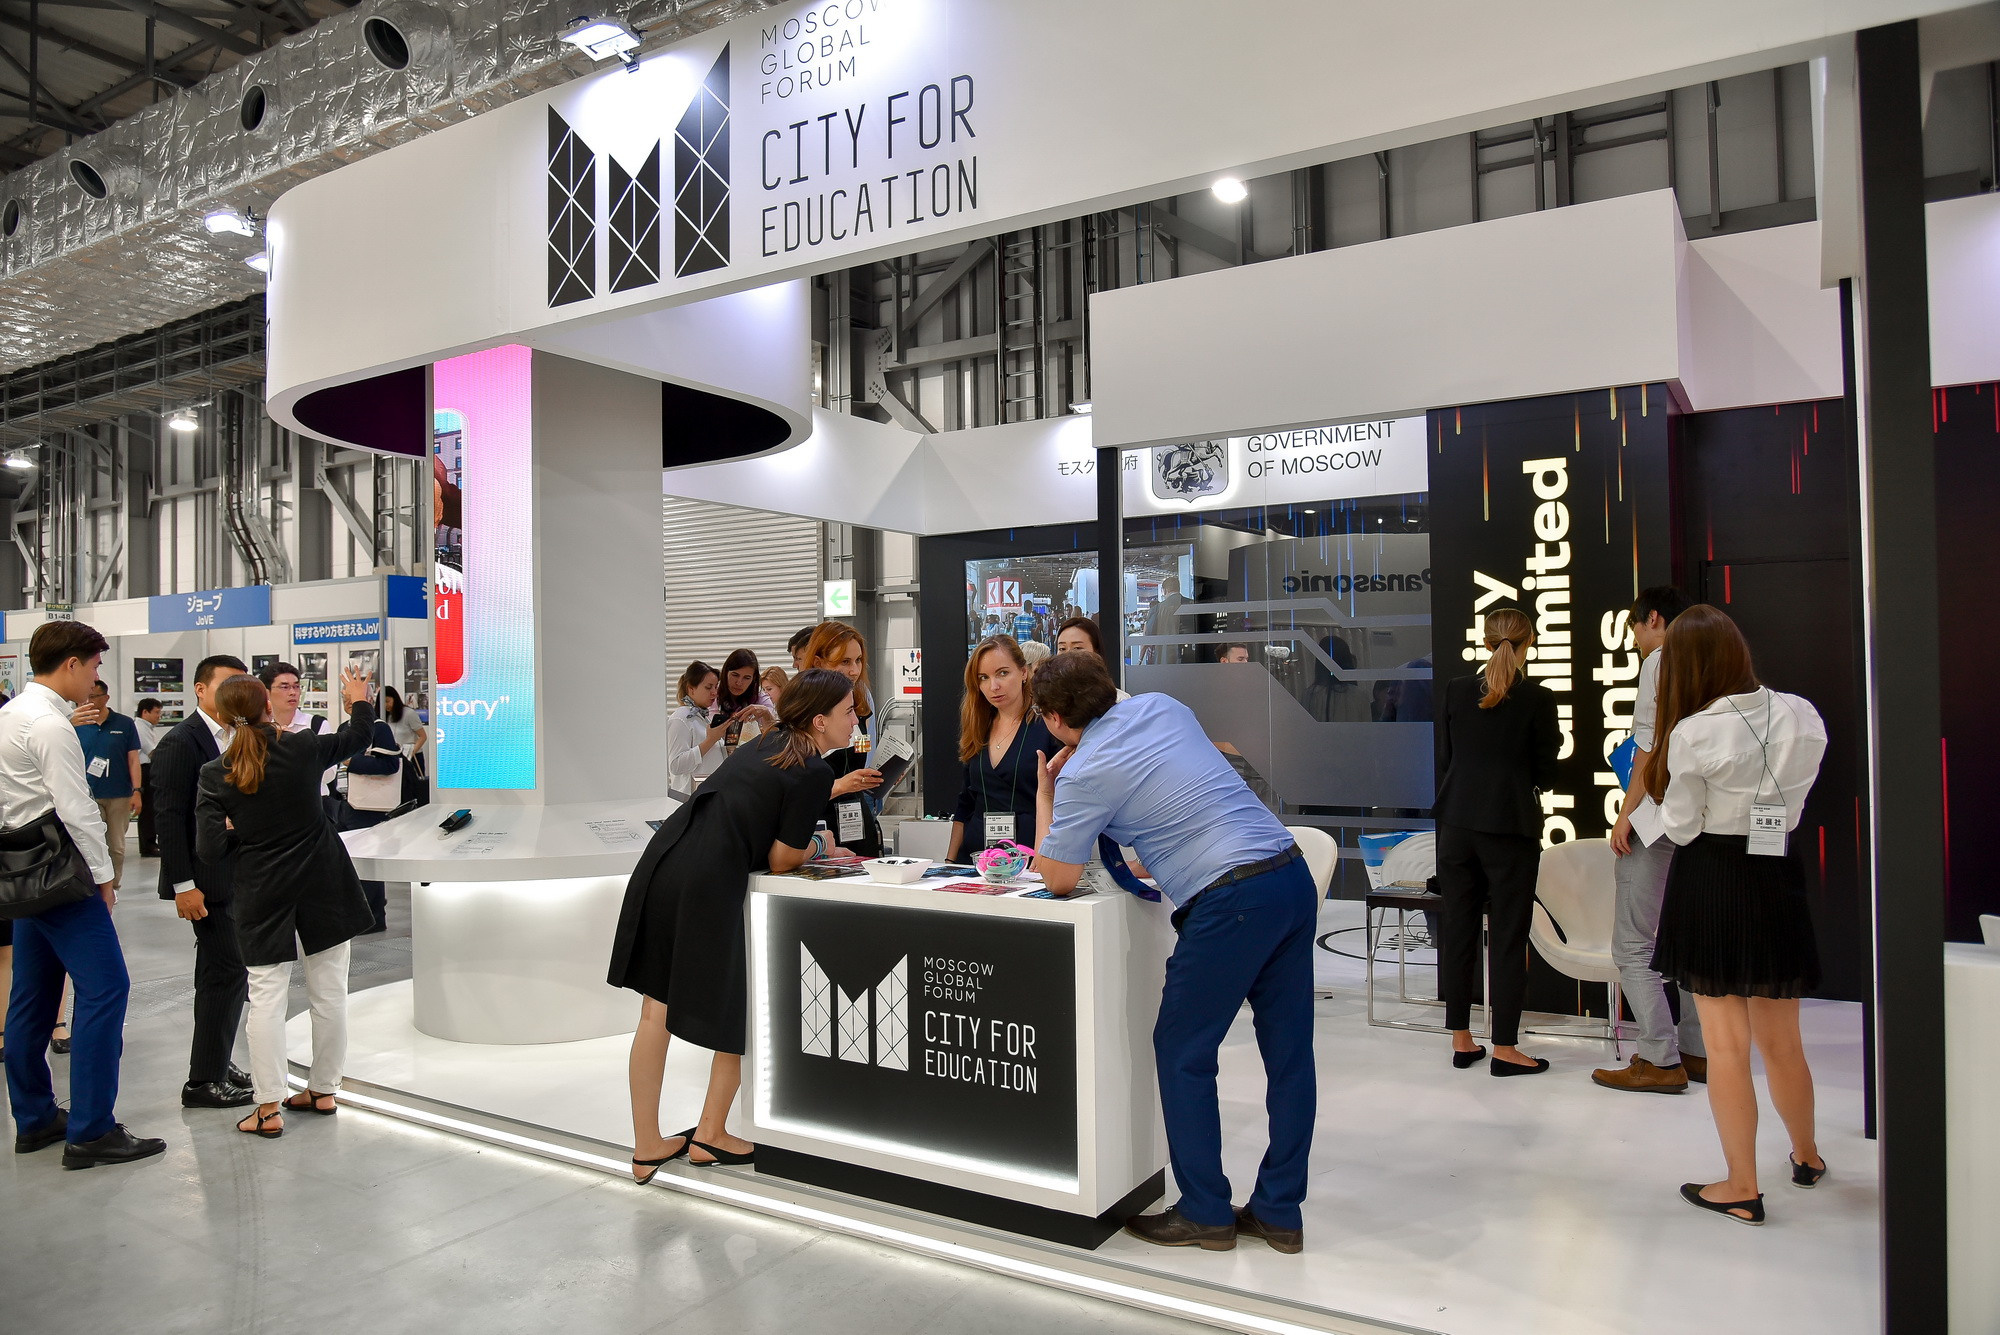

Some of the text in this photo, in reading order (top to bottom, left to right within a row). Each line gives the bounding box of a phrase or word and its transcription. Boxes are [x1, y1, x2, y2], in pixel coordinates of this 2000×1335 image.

[761, 25, 870, 75] GLOBAL
[761, 56, 855, 104] FORUM
[761, 74, 977, 191] CITY FOR
[762, 156, 978, 258] EDUCATION
[1247, 421, 1396, 452] GOVERNMENT
[1247, 449, 1382, 478] OF MOSCOW
[186, 593, 223, 613] ジョーブ
[195, 615, 214, 626] JoVE
[294, 621, 380, 641] 科学するやり方を変えるJoV
[1461, 570, 1518, 675] ity
[1593, 609, 1640, 839] alents
[924, 956, 994, 976] MOSCOW
[924, 971, 983, 990] GLOBAL
[924, 985, 976, 1003] FORUM
[925, 1010, 1036, 1059] CITY FOR
[925, 1048, 1037, 1094] EDUCATION
